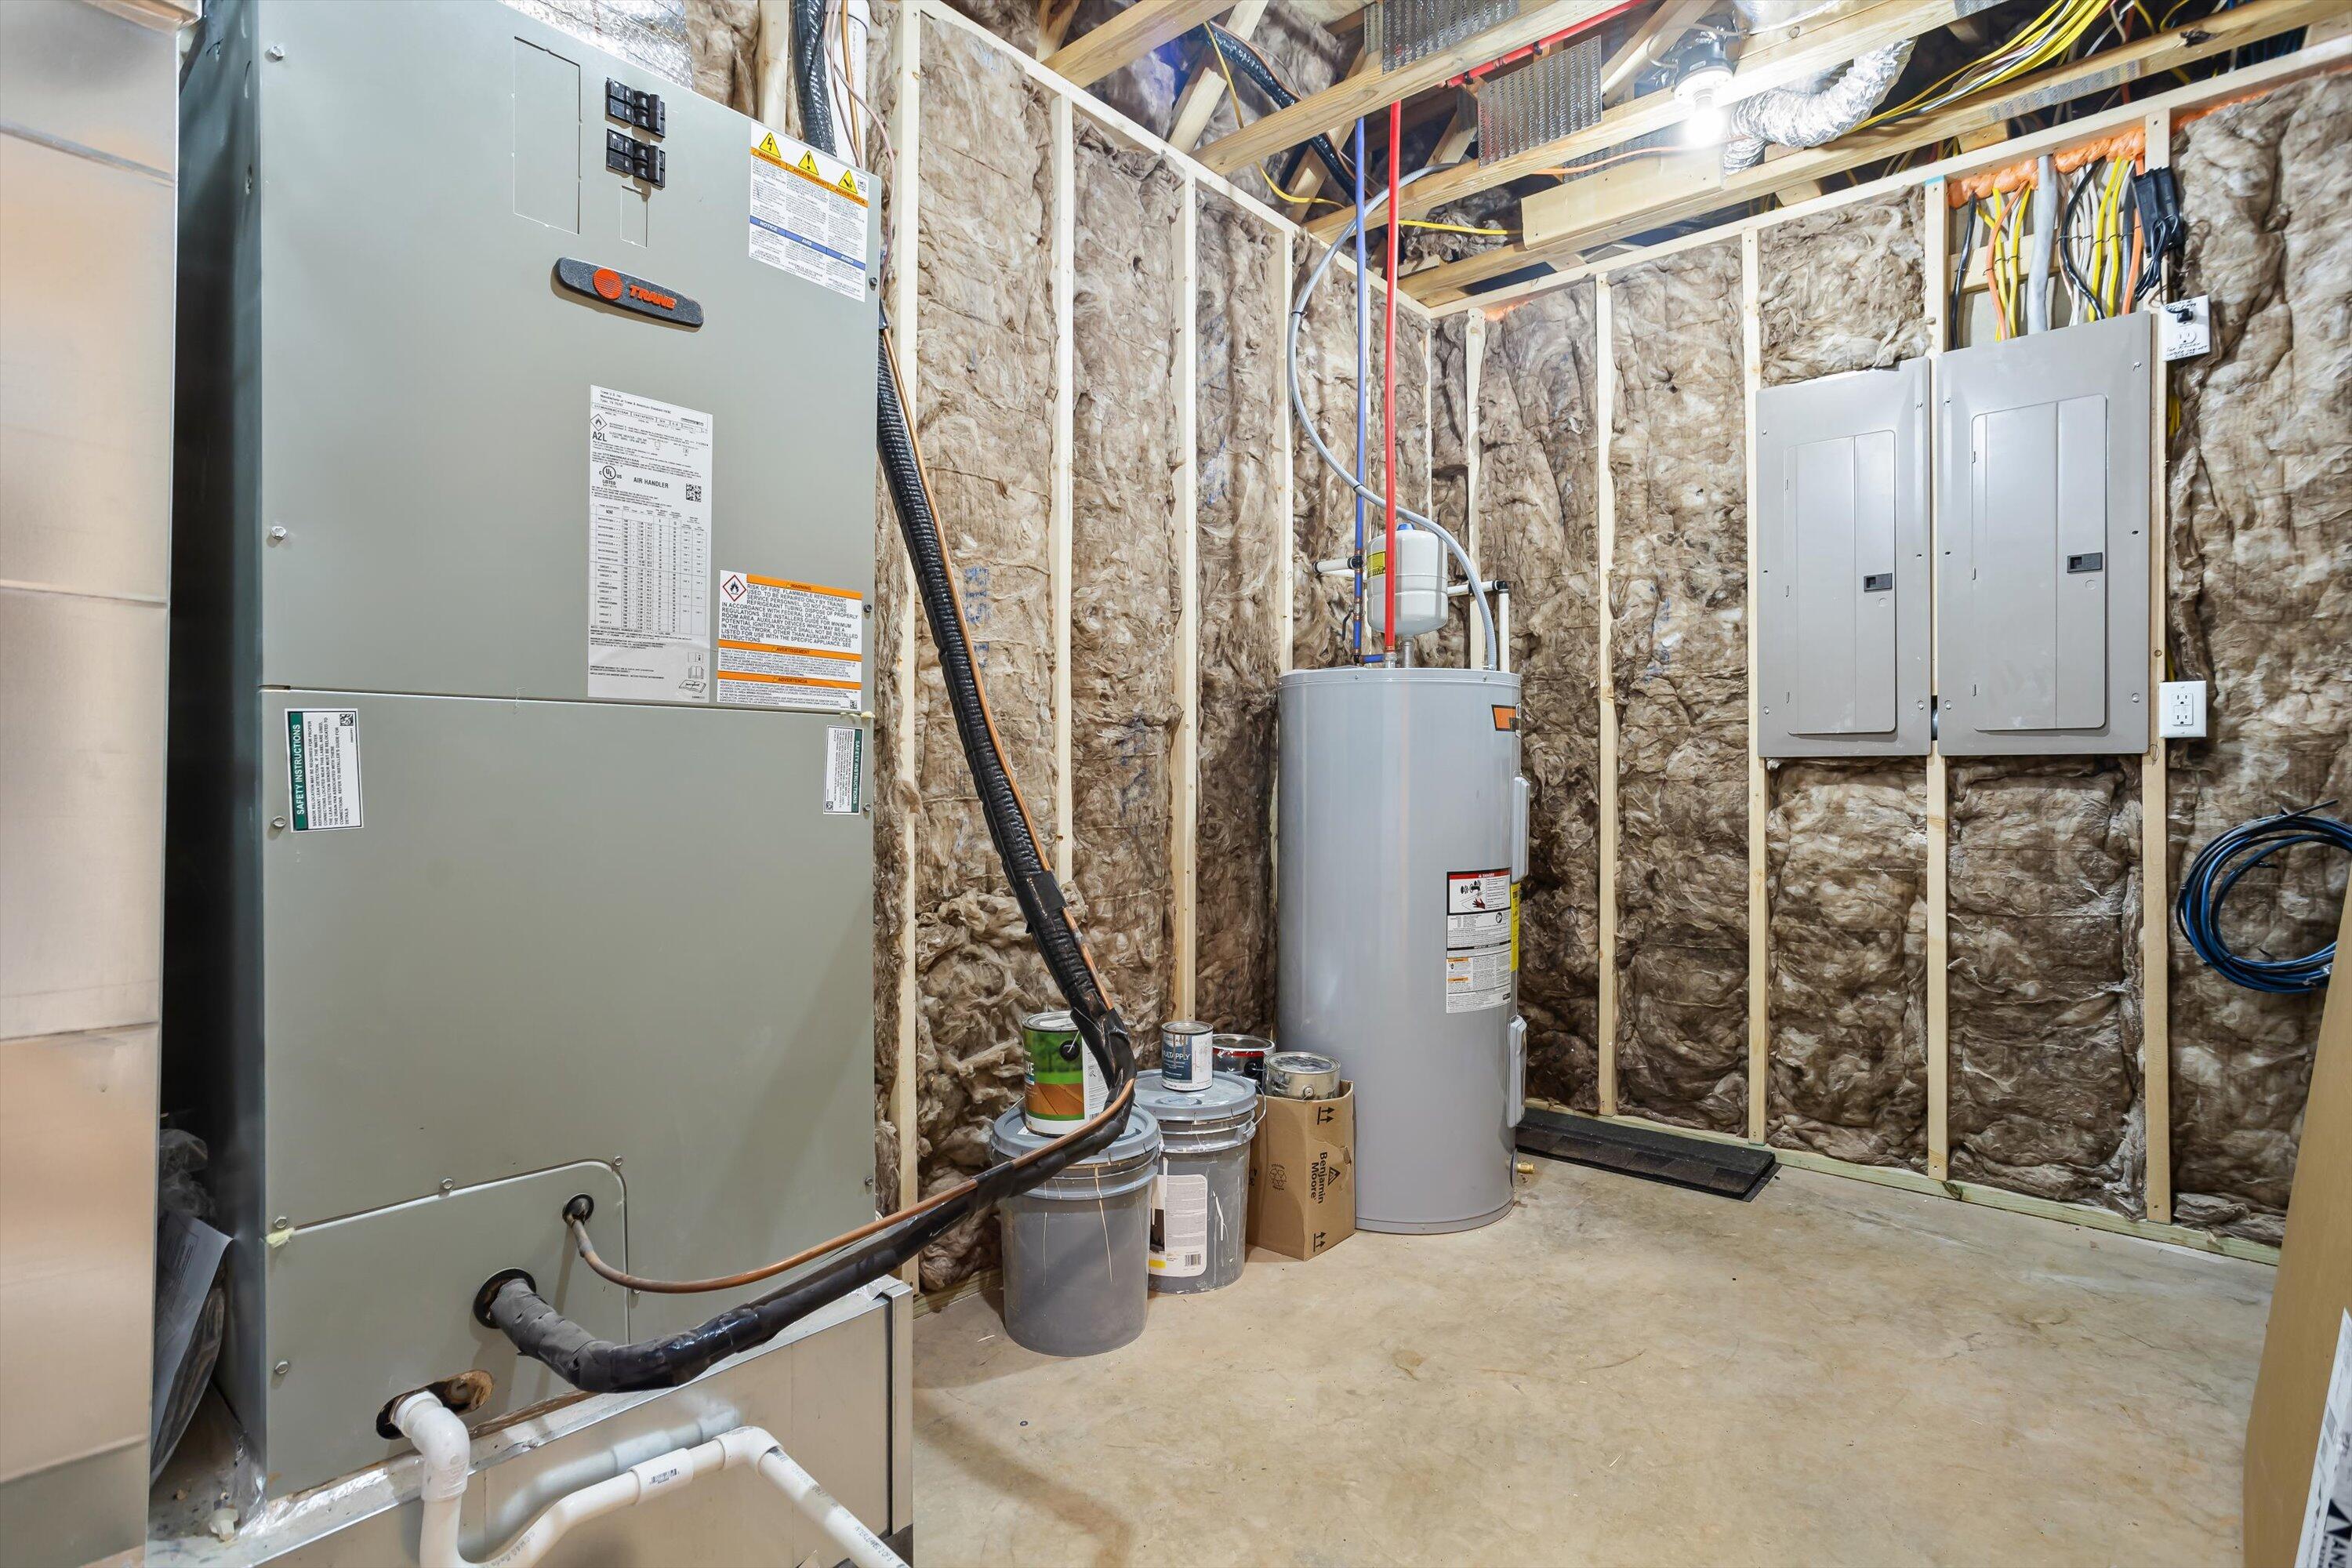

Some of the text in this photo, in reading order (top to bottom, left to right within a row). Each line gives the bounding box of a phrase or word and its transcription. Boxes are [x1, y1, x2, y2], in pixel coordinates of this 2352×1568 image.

[759, 152, 781, 166] WARNING
[793, 168, 826, 187] AVERTISSEMENT
[836, 187, 865, 205] ADVERTENCIA
[760, 220, 777, 232] NOTICE
[630, 285, 677, 310] TRANE
[593, 430, 607, 442] A2L
[644, 479, 669, 488] HANDLER
[783, 590, 812, 598] FLAMMABLE
[814, 594, 846, 603] REFRIGERANT
[729, 603, 766, 612] ACCORDANCE
[746, 600, 783, 609] REFRIGERANT
[774, 614, 803, 622] INSTALLERS
[292, 724, 304, 815] SAFETY INSTRUCTIONS
[1310, 1162, 1319, 1199] Moore
[1318, 1152, 1328, 1204] Benjamin
